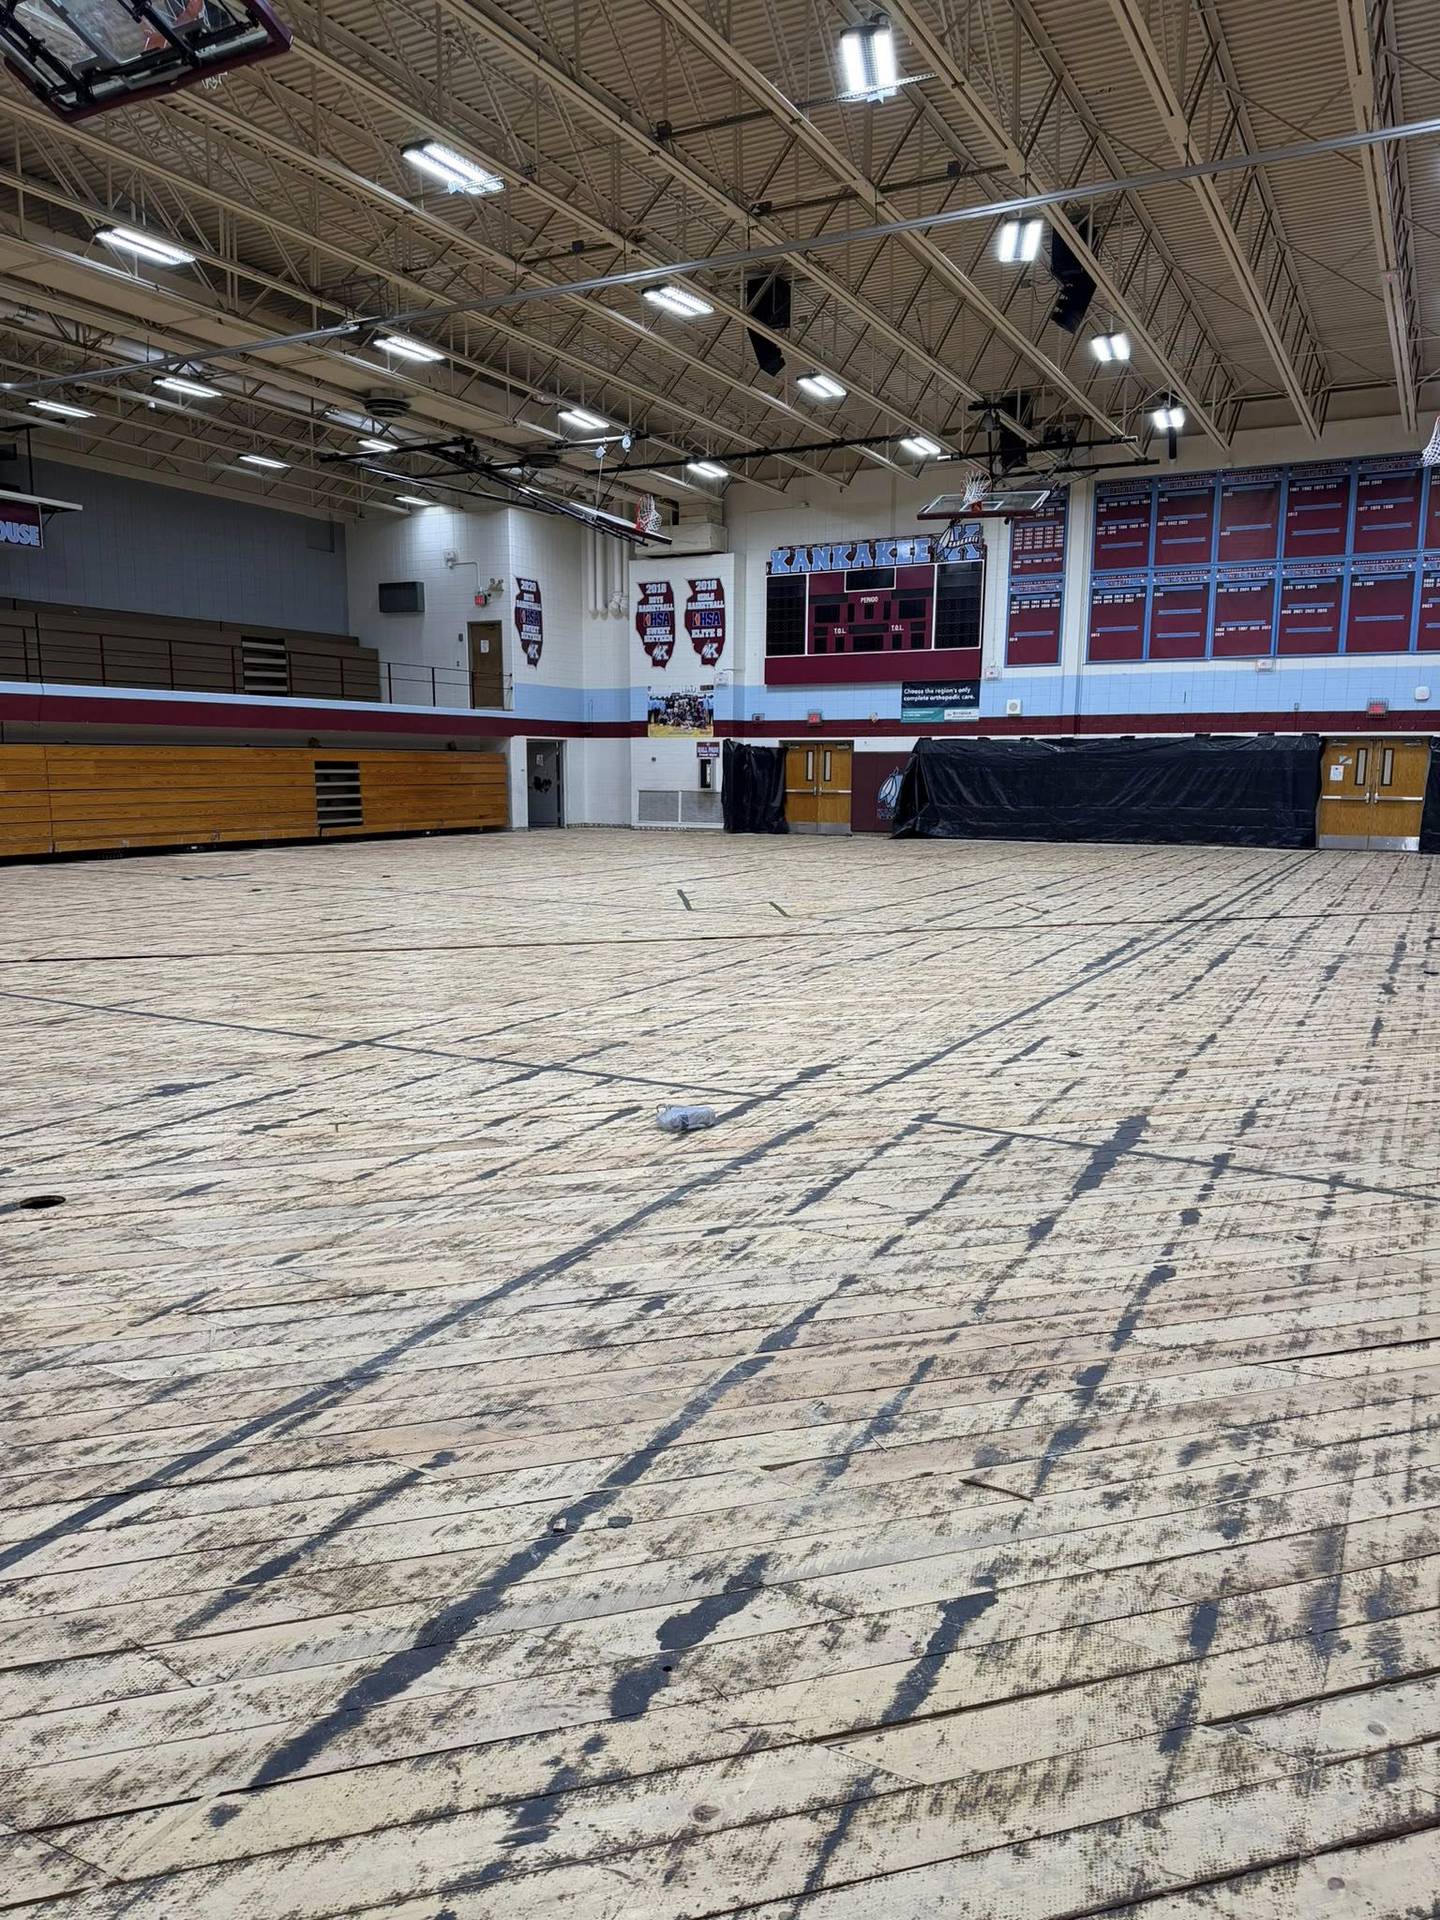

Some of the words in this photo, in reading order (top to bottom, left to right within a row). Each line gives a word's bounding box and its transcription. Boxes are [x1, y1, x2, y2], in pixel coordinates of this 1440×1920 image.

[770, 537, 931, 574] KANKAKEE
[860, 596, 879, 604] PERIOD
[692, 628, 715, 638] ELITE
[958, 686, 971, 694] only
[930, 694, 960, 702] orthopedic
